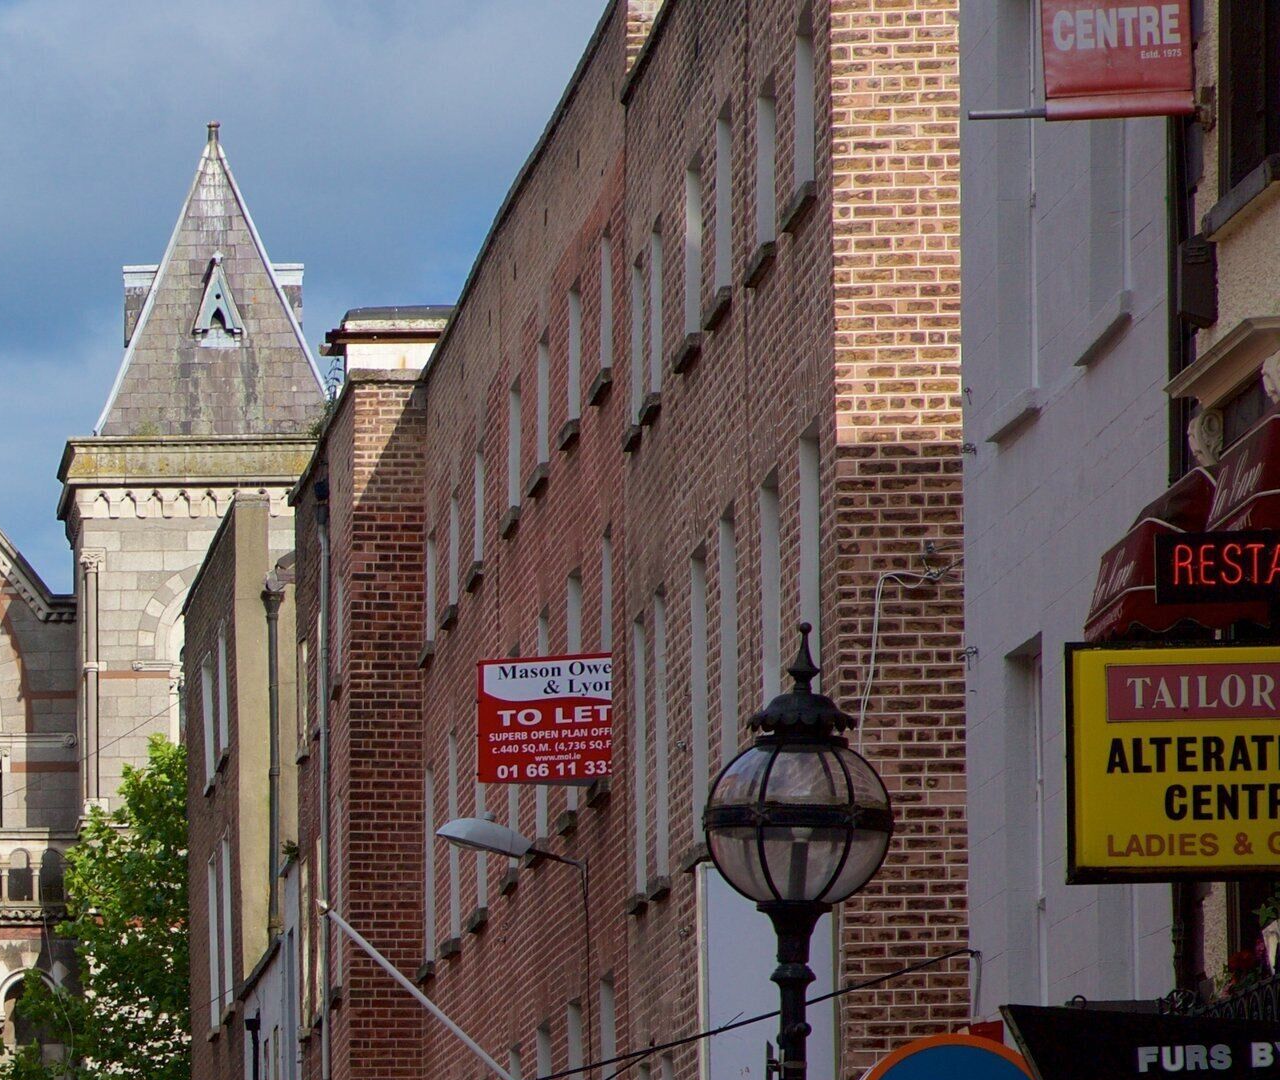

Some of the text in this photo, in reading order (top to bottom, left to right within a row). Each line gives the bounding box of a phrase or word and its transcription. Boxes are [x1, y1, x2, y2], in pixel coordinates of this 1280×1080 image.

[1052, 4, 1181, 50] CENTRE
[498, 661, 612, 680] Mason Owe
[543, 680, 560, 695] &
[497, 705, 612, 726] TO LET
[489, 732, 528, 742] SUPERB
[531, 730, 558, 740] OPEN
[561, 729, 588, 739] PLAN
[492, 744, 519, 754] c.440
[522, 743, 551, 753] SQ.M.
[554, 741, 587, 752] (4,736
[1106, 735, 1280, 774] ALTERAT
[497, 765, 519, 779] 01
[526, 764, 549, 778] 66
[556, 762, 576, 776] 11
[1107, 832, 1220, 858] LADIES
[1233, 832, 1254, 856] &
[1136, 1041, 1280, 1073] FURS B
